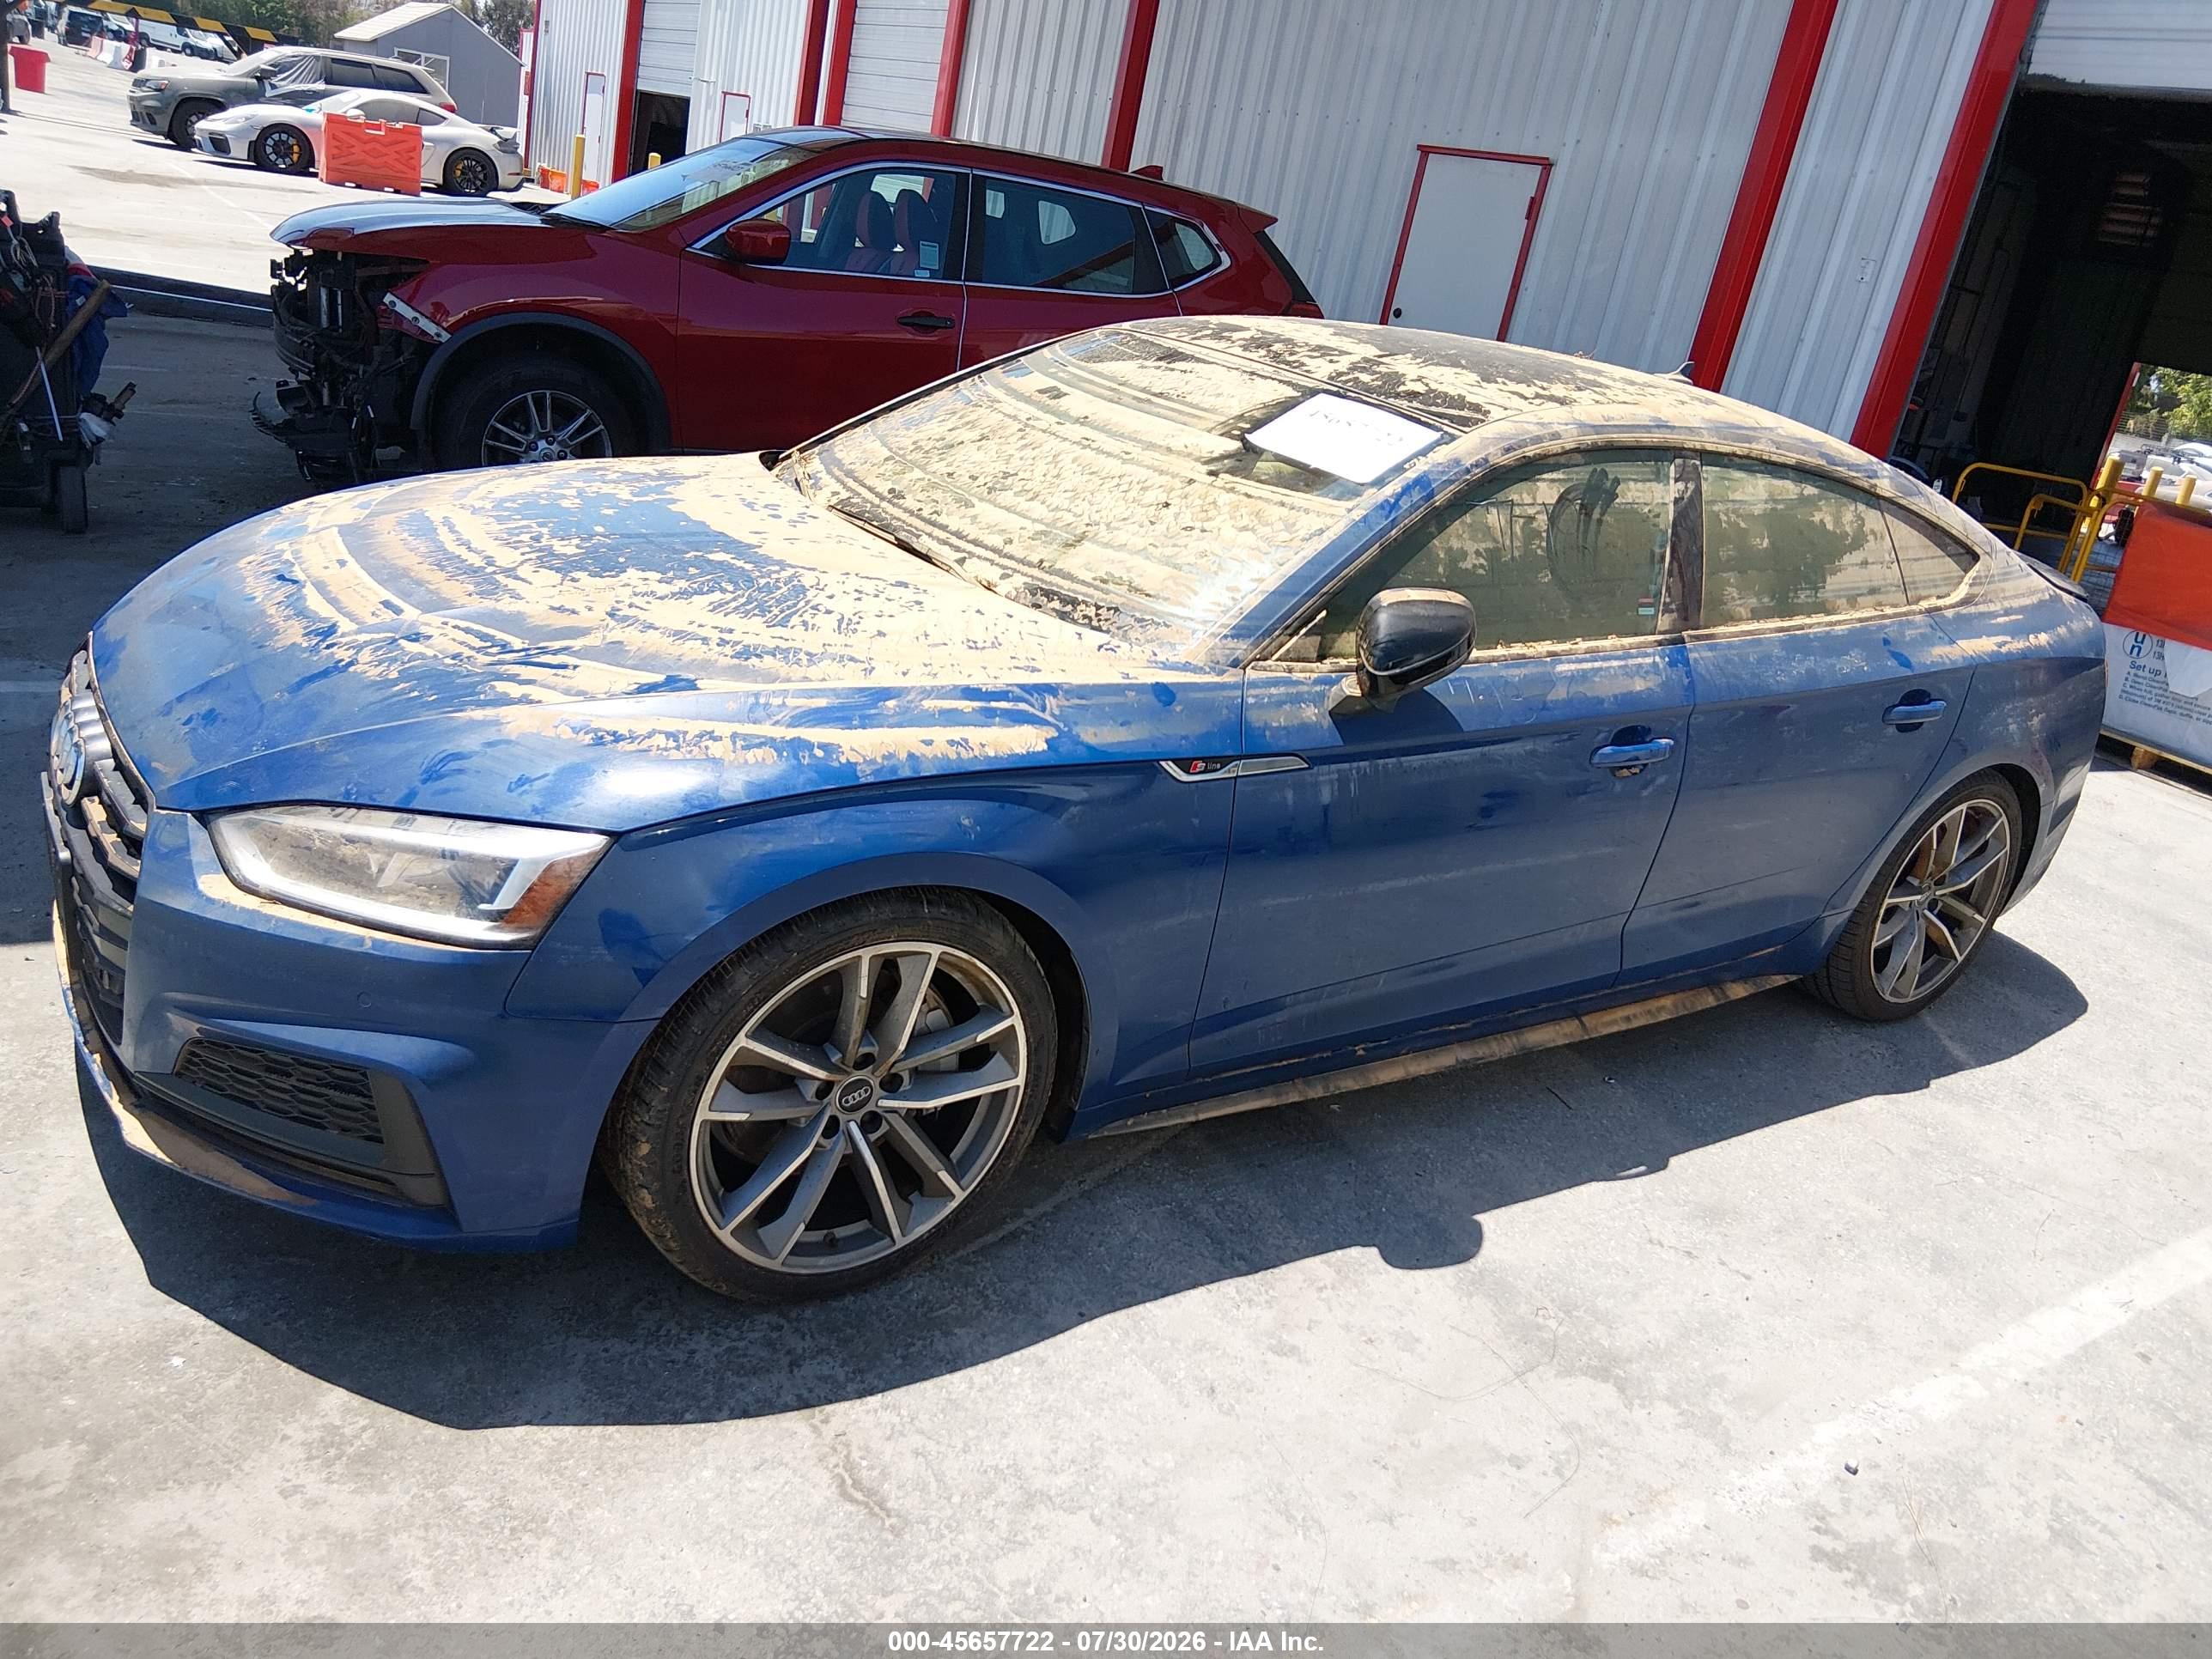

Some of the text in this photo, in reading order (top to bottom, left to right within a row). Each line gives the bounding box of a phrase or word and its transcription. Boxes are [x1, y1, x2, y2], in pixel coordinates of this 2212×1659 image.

[2130, 660, 2146, 672] Set
[2148, 667, 2161, 678] up
[1207, 762, 1221, 770] line
